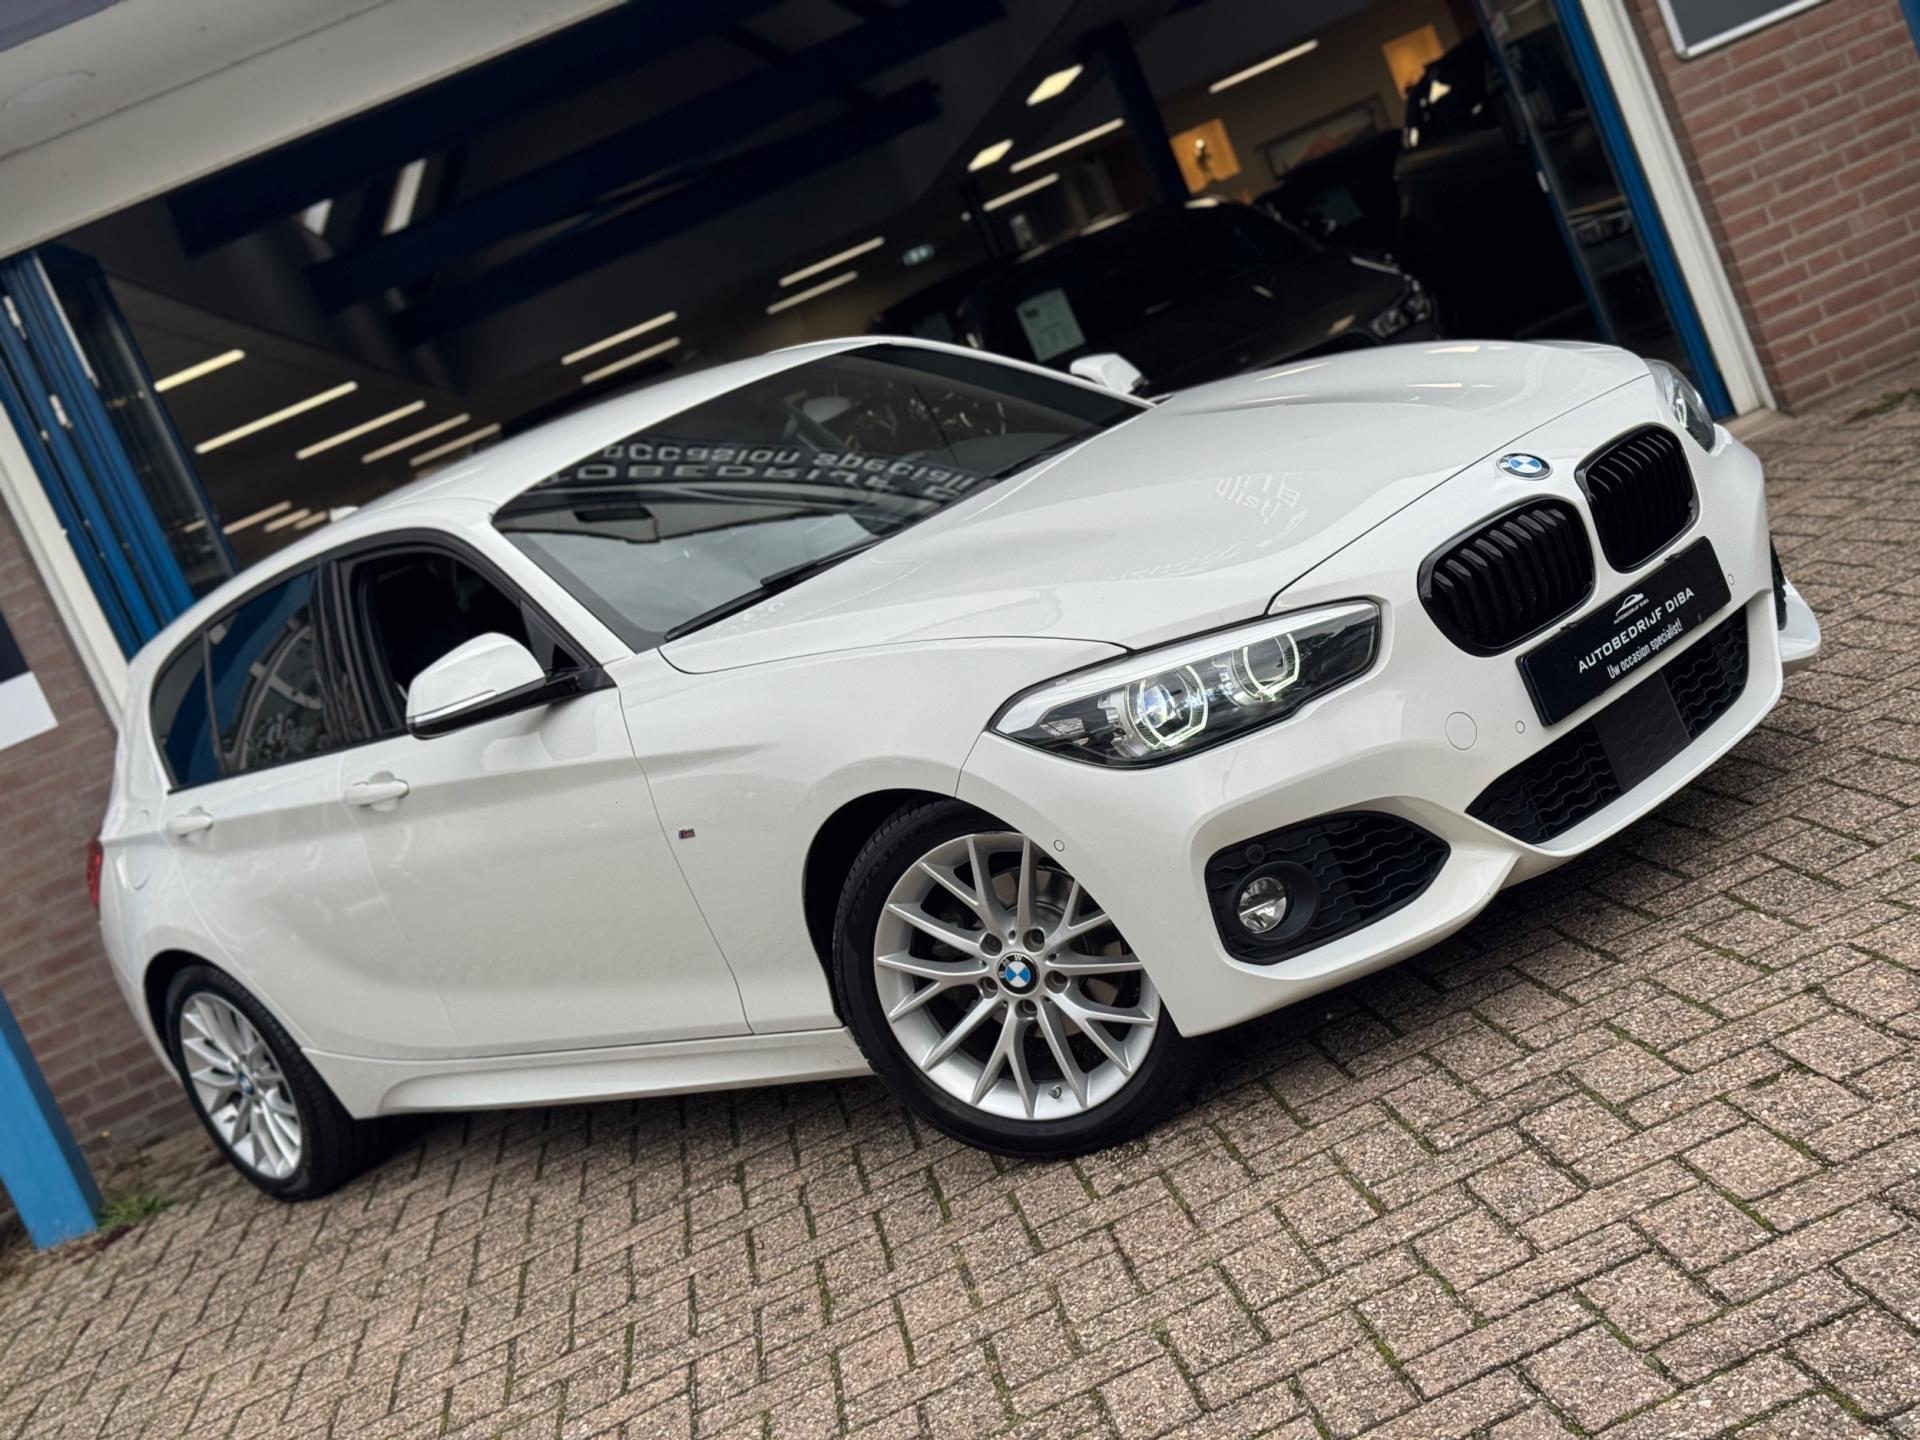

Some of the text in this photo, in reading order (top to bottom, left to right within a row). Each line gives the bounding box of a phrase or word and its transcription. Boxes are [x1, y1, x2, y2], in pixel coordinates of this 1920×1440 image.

[1579, 587, 1695, 674] AUTOBEDRIJF DIBA
[1607, 617, 1684, 679] Uw occasion specialist!
